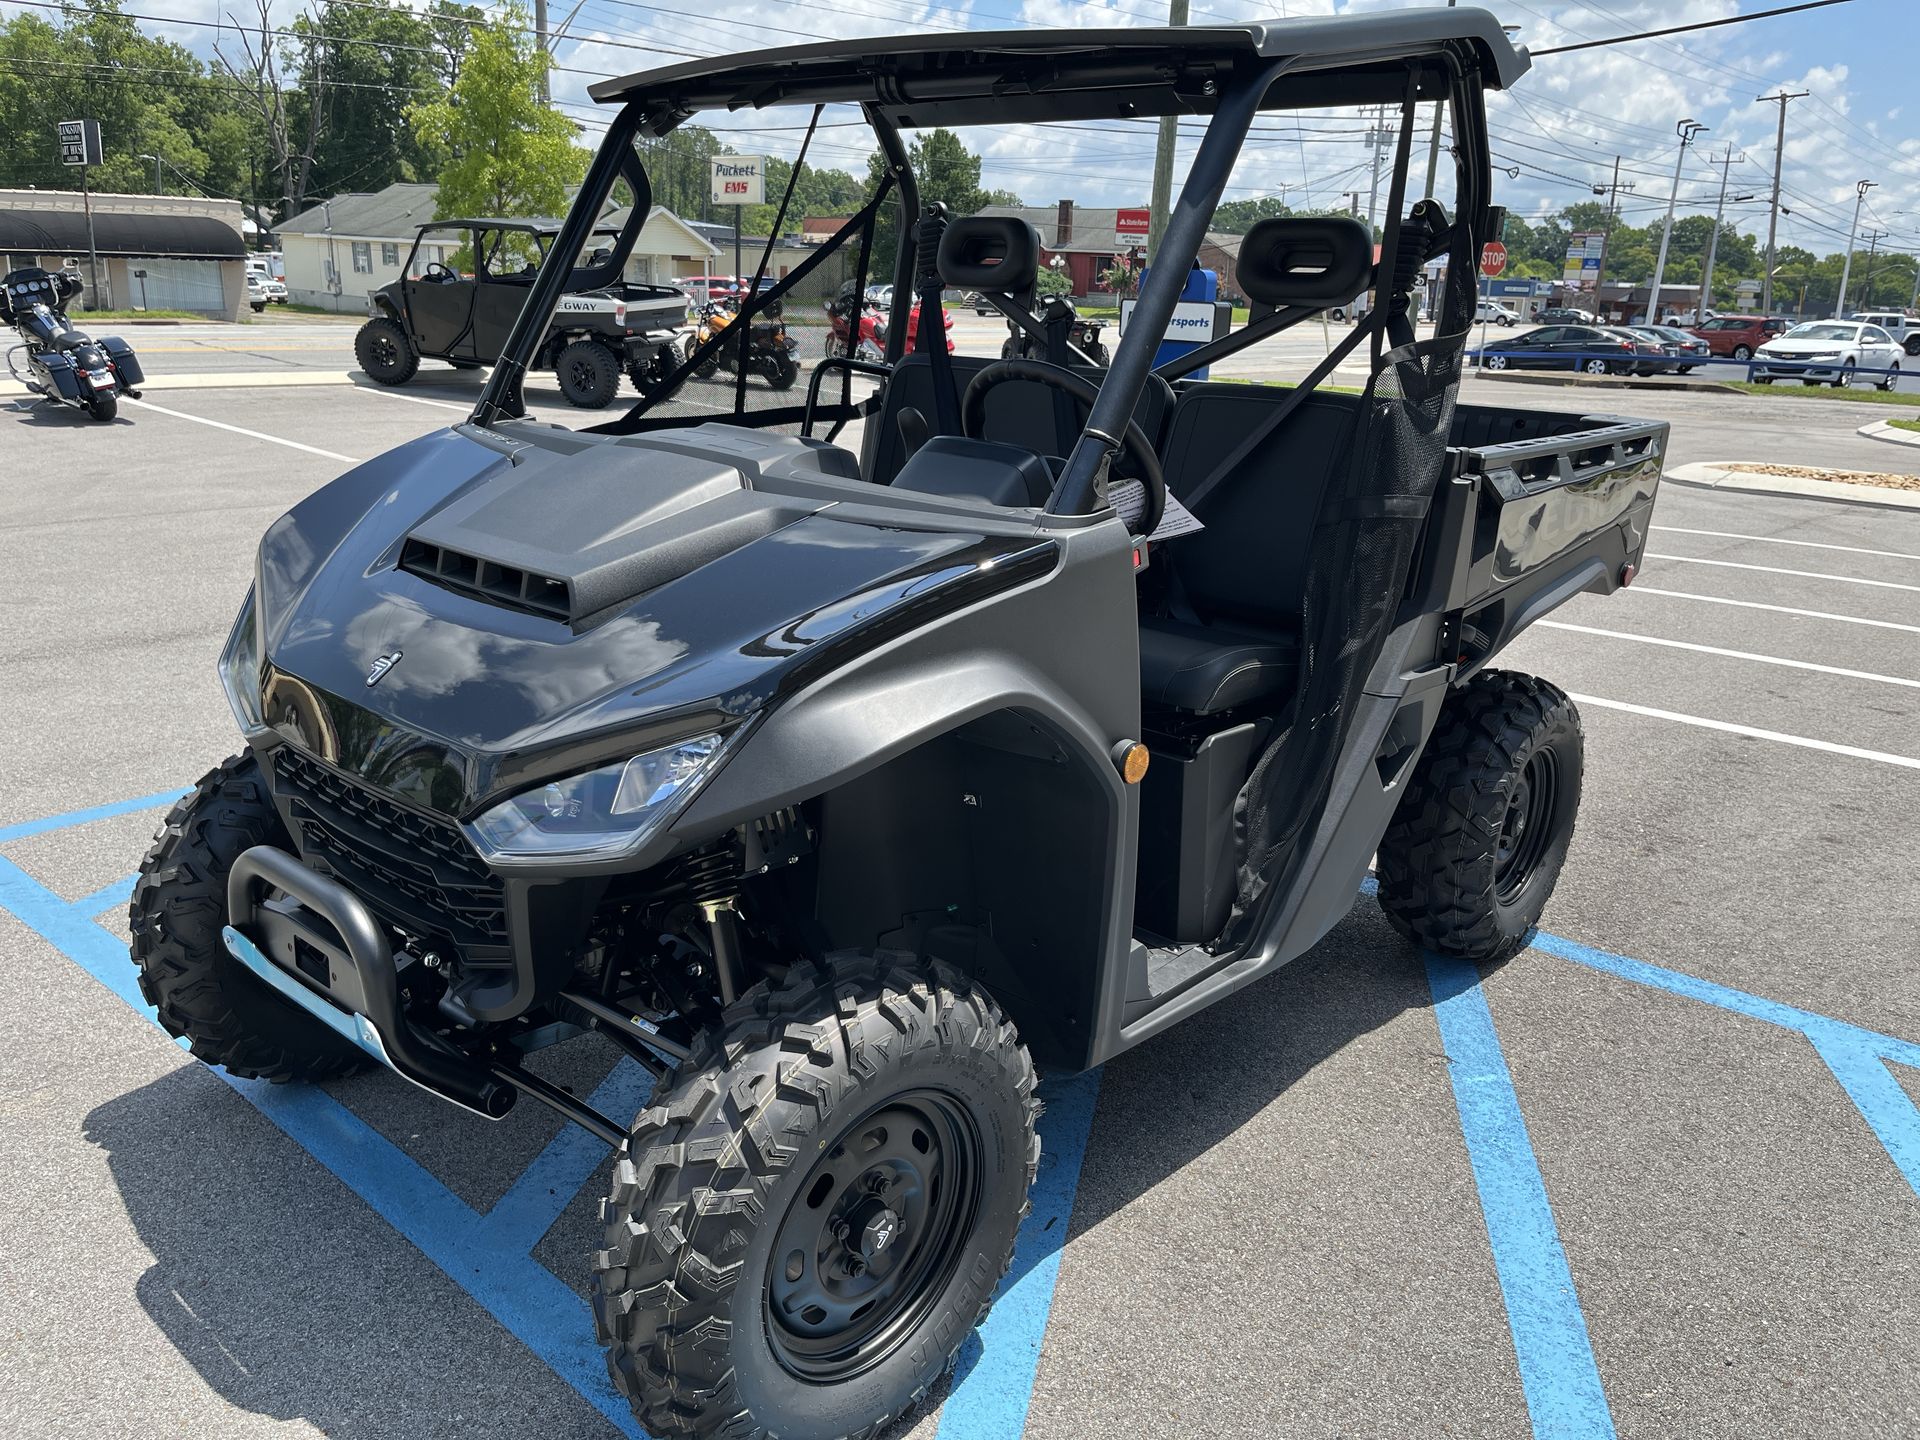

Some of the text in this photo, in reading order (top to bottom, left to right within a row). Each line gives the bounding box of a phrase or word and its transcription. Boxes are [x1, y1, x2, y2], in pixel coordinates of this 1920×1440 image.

[716, 164, 755, 176] Puckett
[725, 182, 748, 193] EMS
[1481, 252, 1505, 266] STOP
